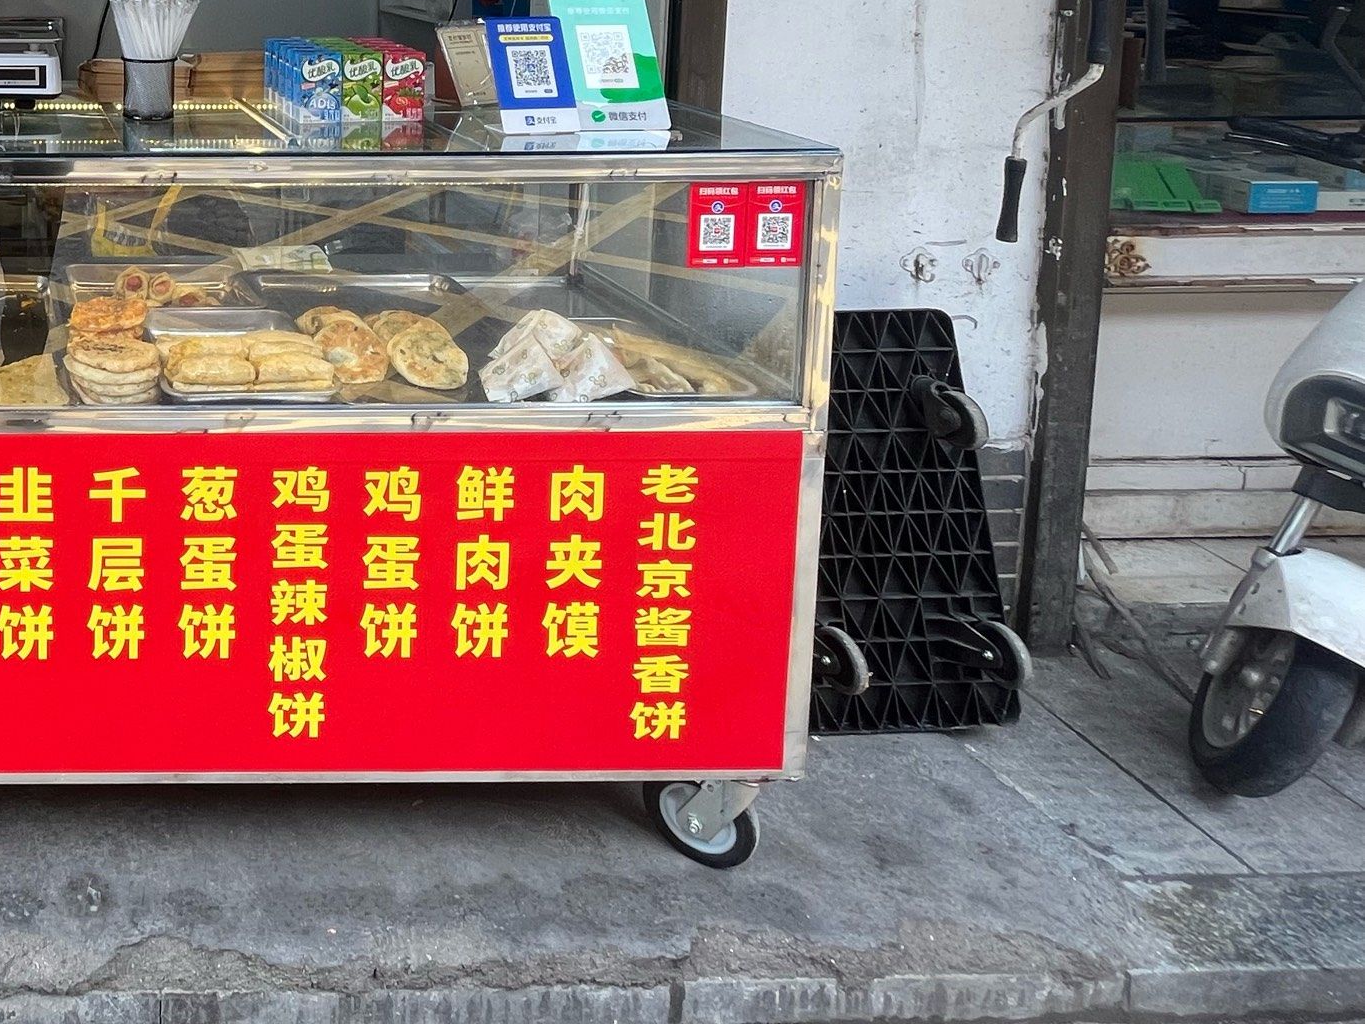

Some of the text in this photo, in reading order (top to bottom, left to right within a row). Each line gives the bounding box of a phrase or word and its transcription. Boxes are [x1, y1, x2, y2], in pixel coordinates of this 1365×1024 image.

[307, 64, 337, 79] 优酸乳
[349, 63, 378, 79] 优酸乳
[391, 61, 419, 77] 优酸乳
[497, 23, 552, 33] 推荐使用支付宝
[536, 115, 557, 125] 支付宝
[608, 109, 647, 122] 微信支付
[86, 467, 146, 660] 千层饼
[177, 466, 238, 659] 葱蛋饼
[267, 466, 330, 738] 鸡蛋辣椒饼
[359, 465, 422, 658] 鸡蛋饼
[450, 465, 515, 658] 鲜肉饼
[542, 464, 605, 658] 肉夹馍
[630, 464, 699, 740] 老北京酱香饼
